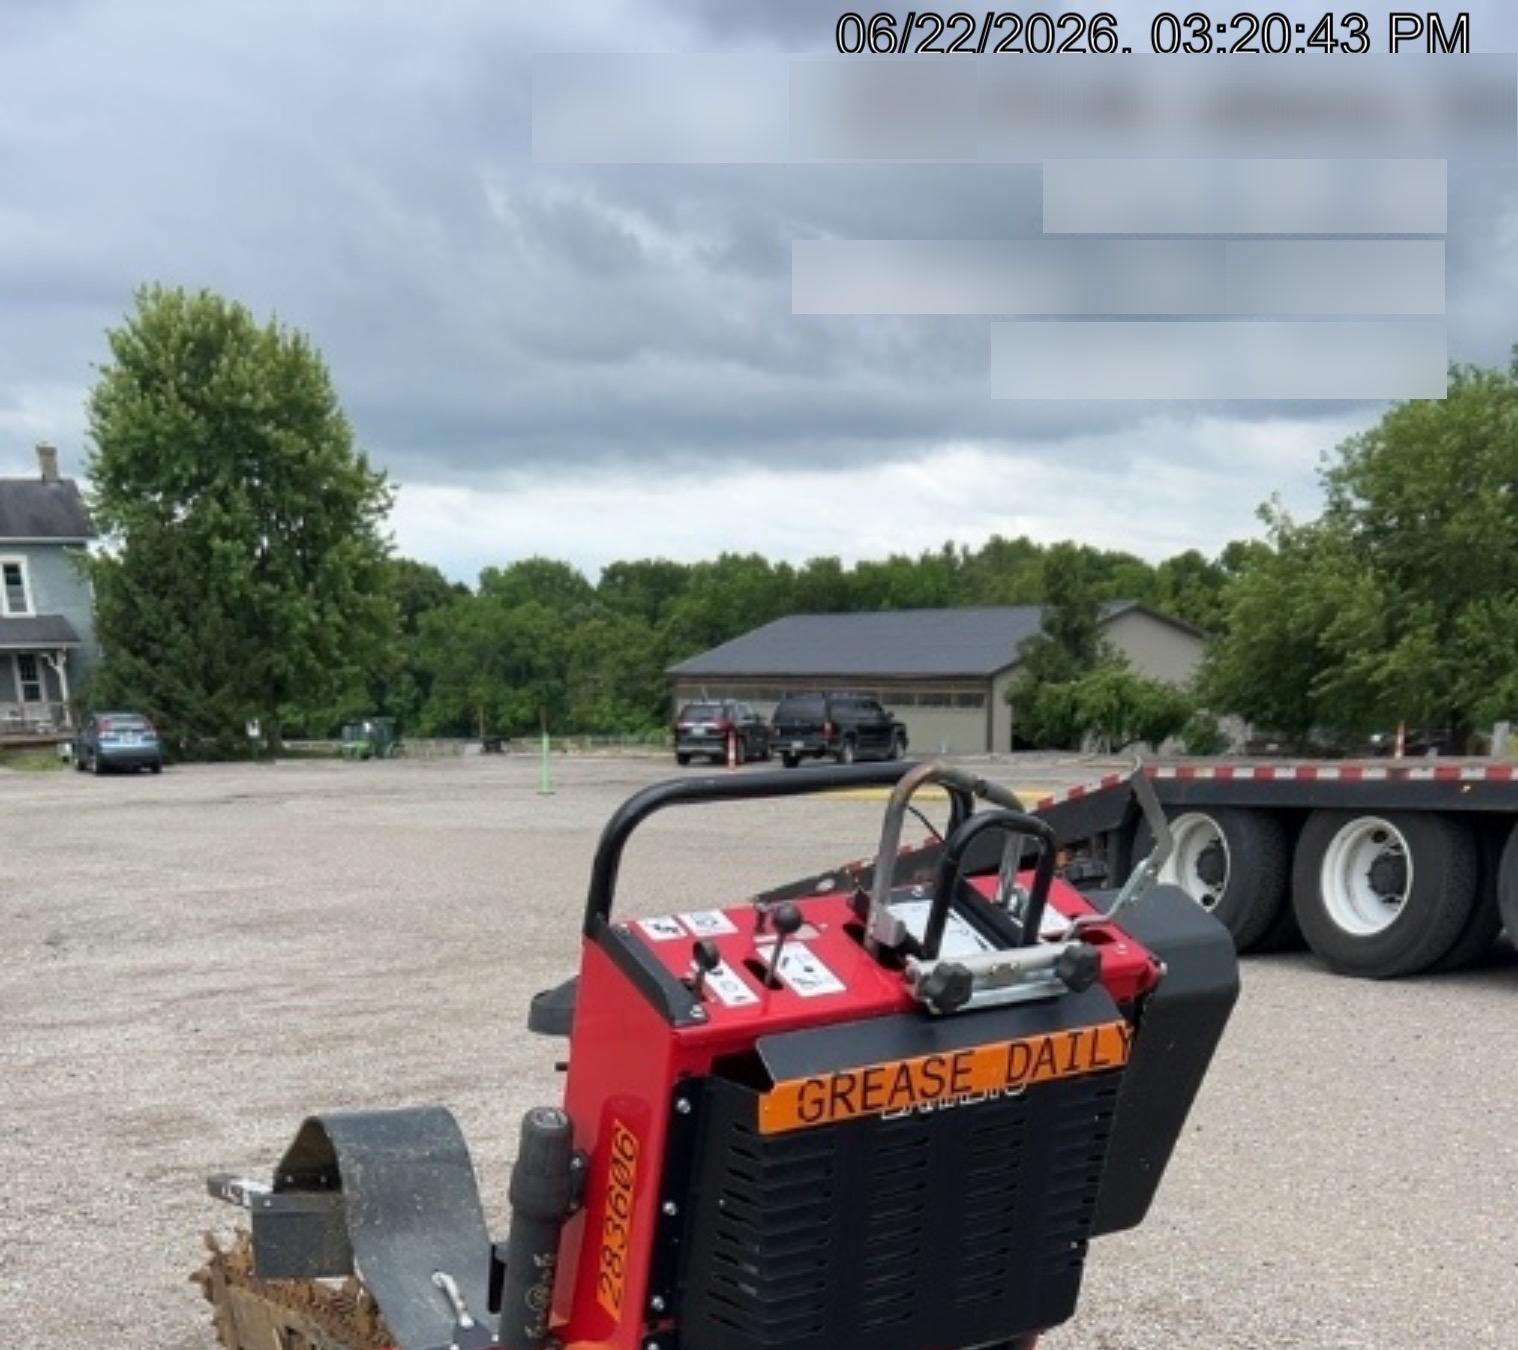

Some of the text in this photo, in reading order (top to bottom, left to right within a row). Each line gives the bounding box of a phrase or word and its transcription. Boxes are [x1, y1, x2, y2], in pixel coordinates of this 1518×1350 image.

[797, 1050, 976, 1123] GREASE
[1005, 1025, 1132, 1084] DAILY
[600, 1127, 635, 1310] 283606
